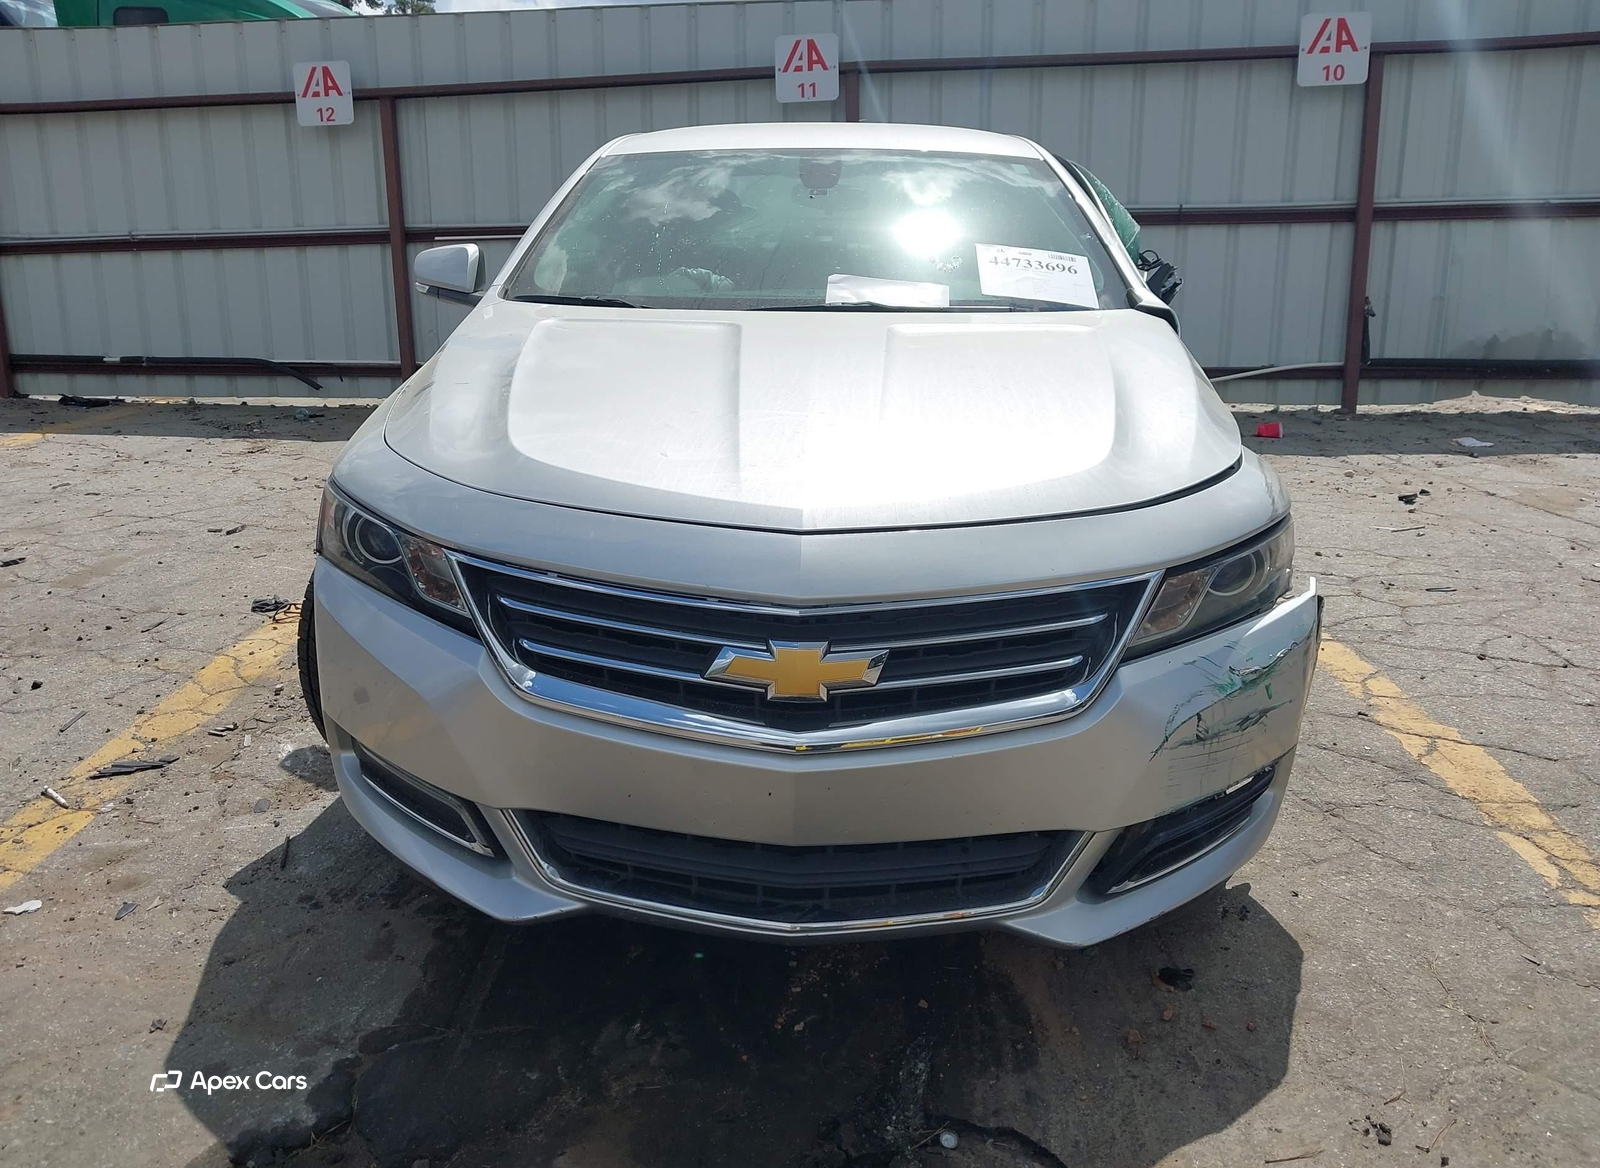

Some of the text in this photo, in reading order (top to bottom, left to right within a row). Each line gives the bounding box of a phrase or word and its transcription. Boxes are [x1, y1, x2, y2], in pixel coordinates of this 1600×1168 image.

[1322, 64, 1345, 82] 10
[797, 82, 817, 98] 11
[316, 106, 336, 122] 12
[989, 255, 1078, 275] 44733696
